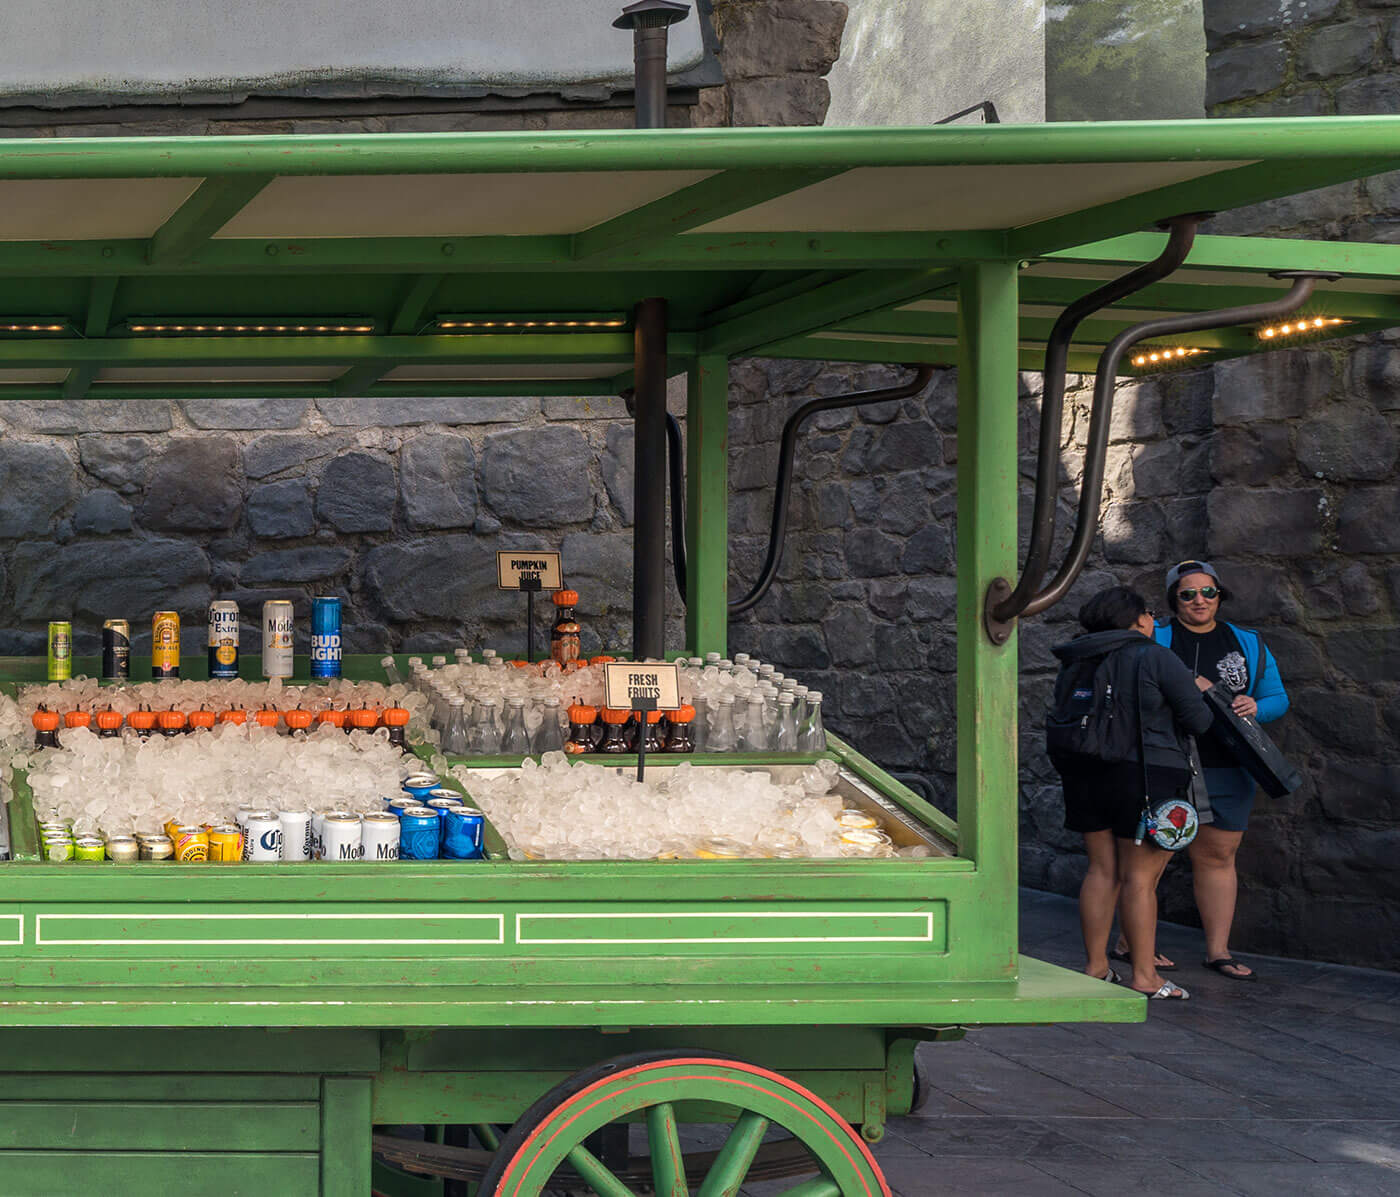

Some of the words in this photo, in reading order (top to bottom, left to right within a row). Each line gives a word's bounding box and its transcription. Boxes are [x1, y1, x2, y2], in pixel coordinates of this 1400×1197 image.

[511, 560, 547, 570] PUMPKIN
[518, 571, 541, 580] JUICE
[311, 635, 341, 647] BUD
[311, 648, 342, 660] IGHT
[629, 674, 658, 685] FRESH
[628, 687, 660, 699] FRUITS
